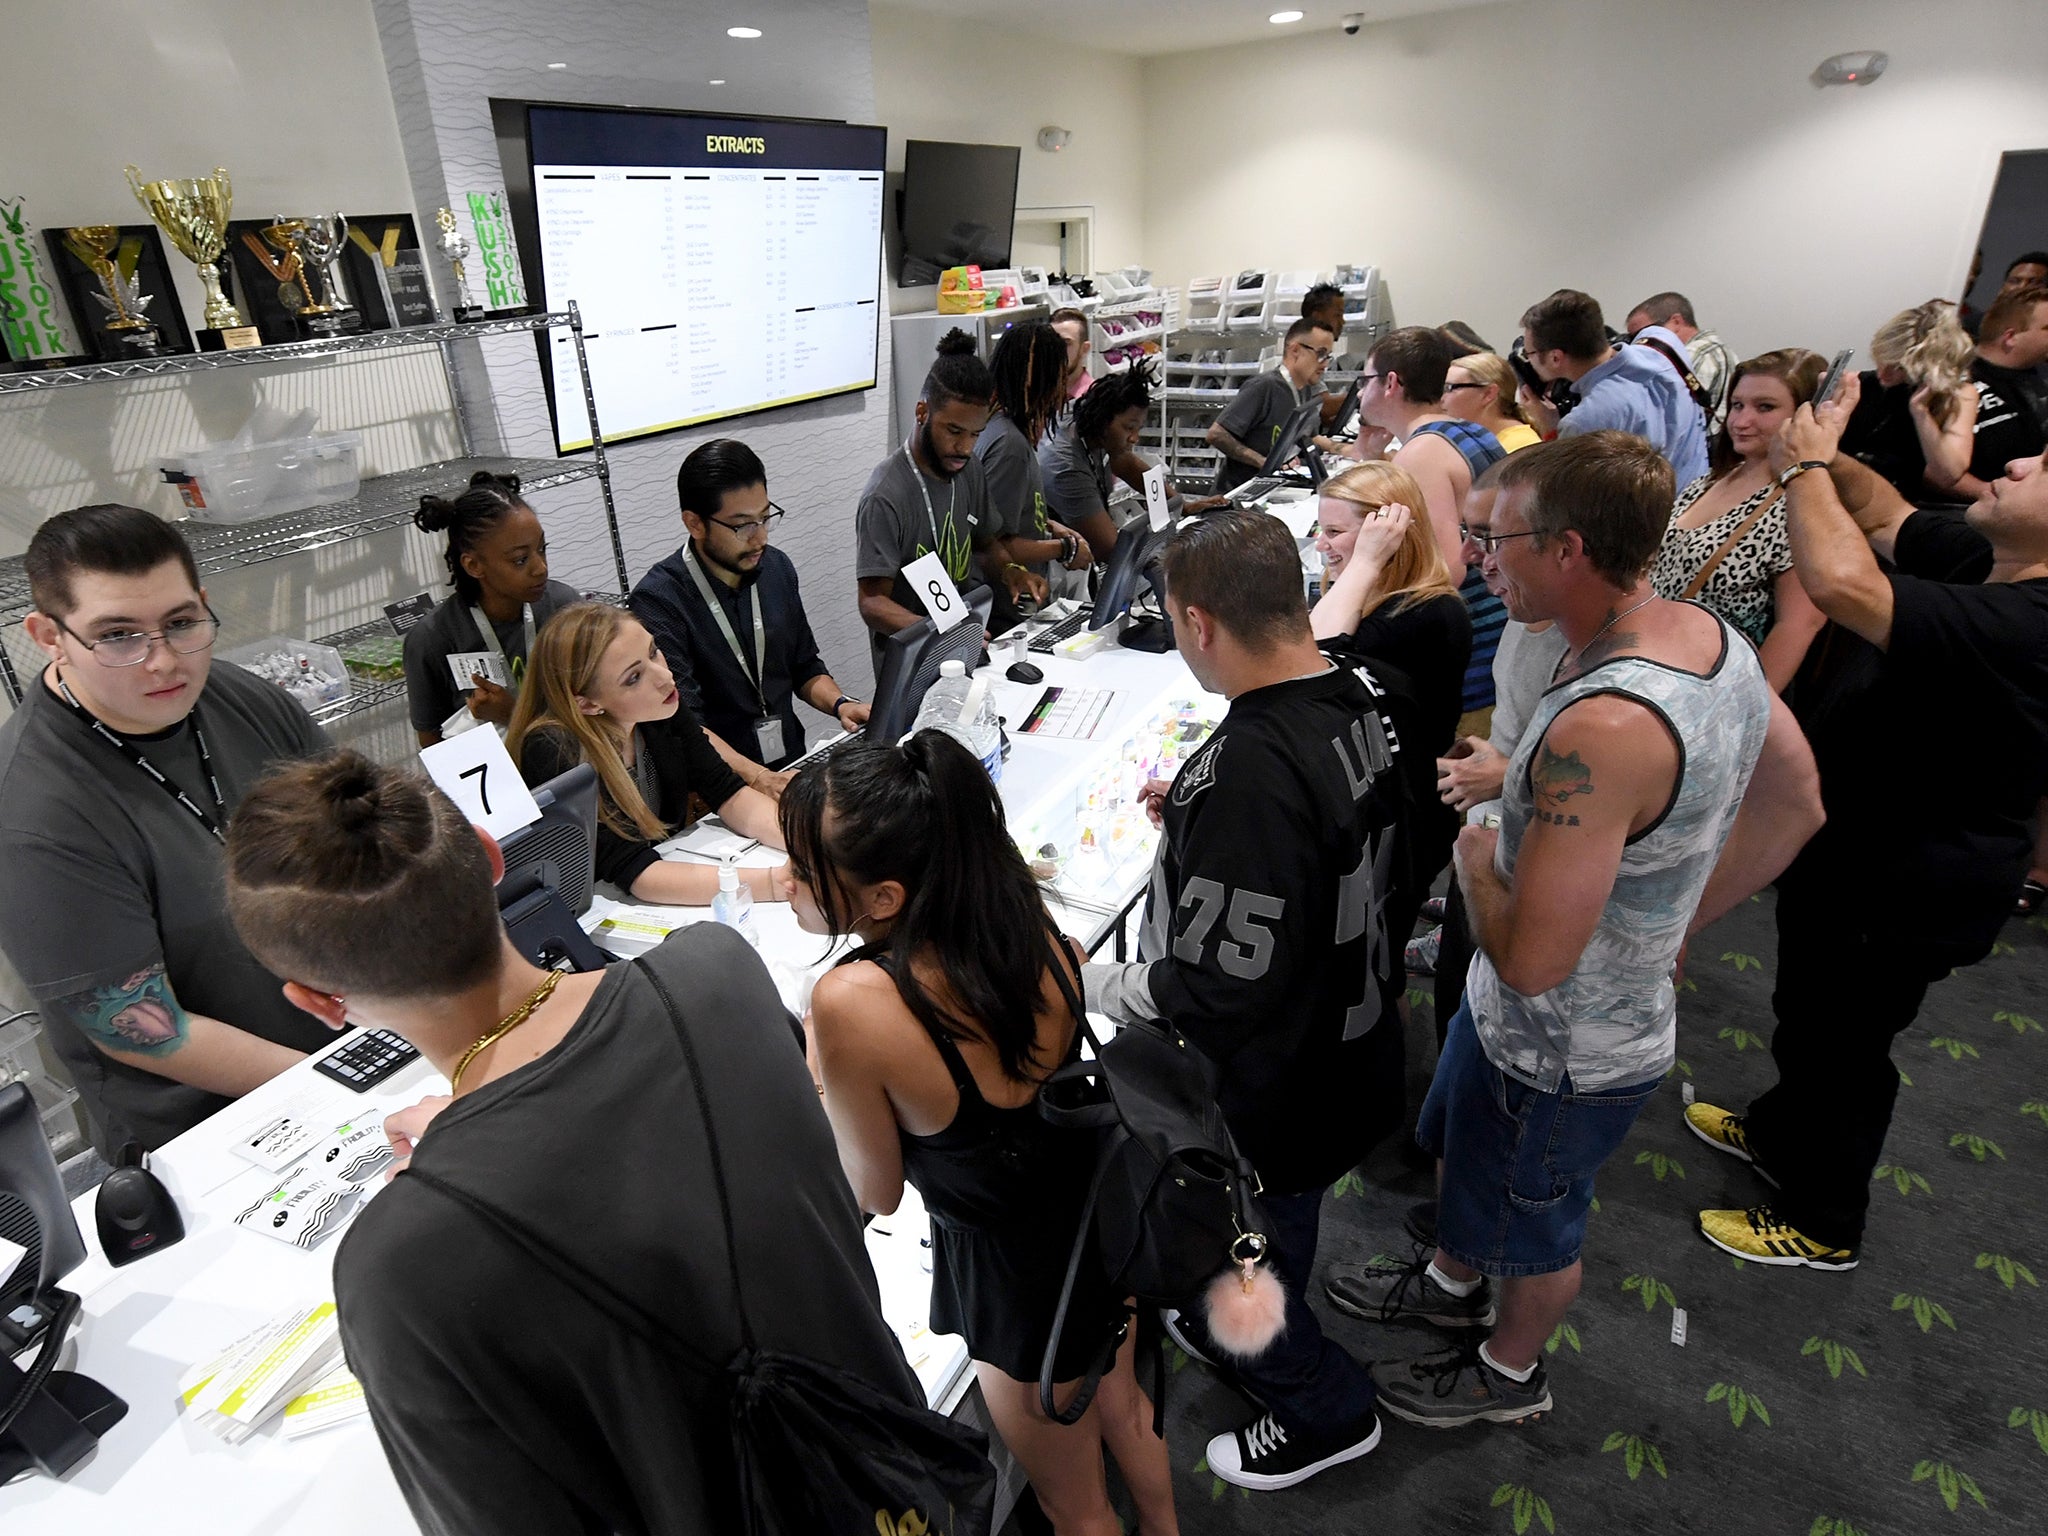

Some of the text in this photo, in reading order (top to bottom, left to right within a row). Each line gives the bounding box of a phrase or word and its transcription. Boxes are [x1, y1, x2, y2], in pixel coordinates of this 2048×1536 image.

[706, 135, 765, 154] EXTRACTS
[467, 191, 510, 308] KUSH
[496, 219, 522, 305] STOCK
[14, 236, 66, 353] STOCK
[1151, 480, 1159, 502] 9
[928, 580, 951, 612] 8
[459, 763, 492, 815] 7
[1173, 876, 1286, 981] 75
